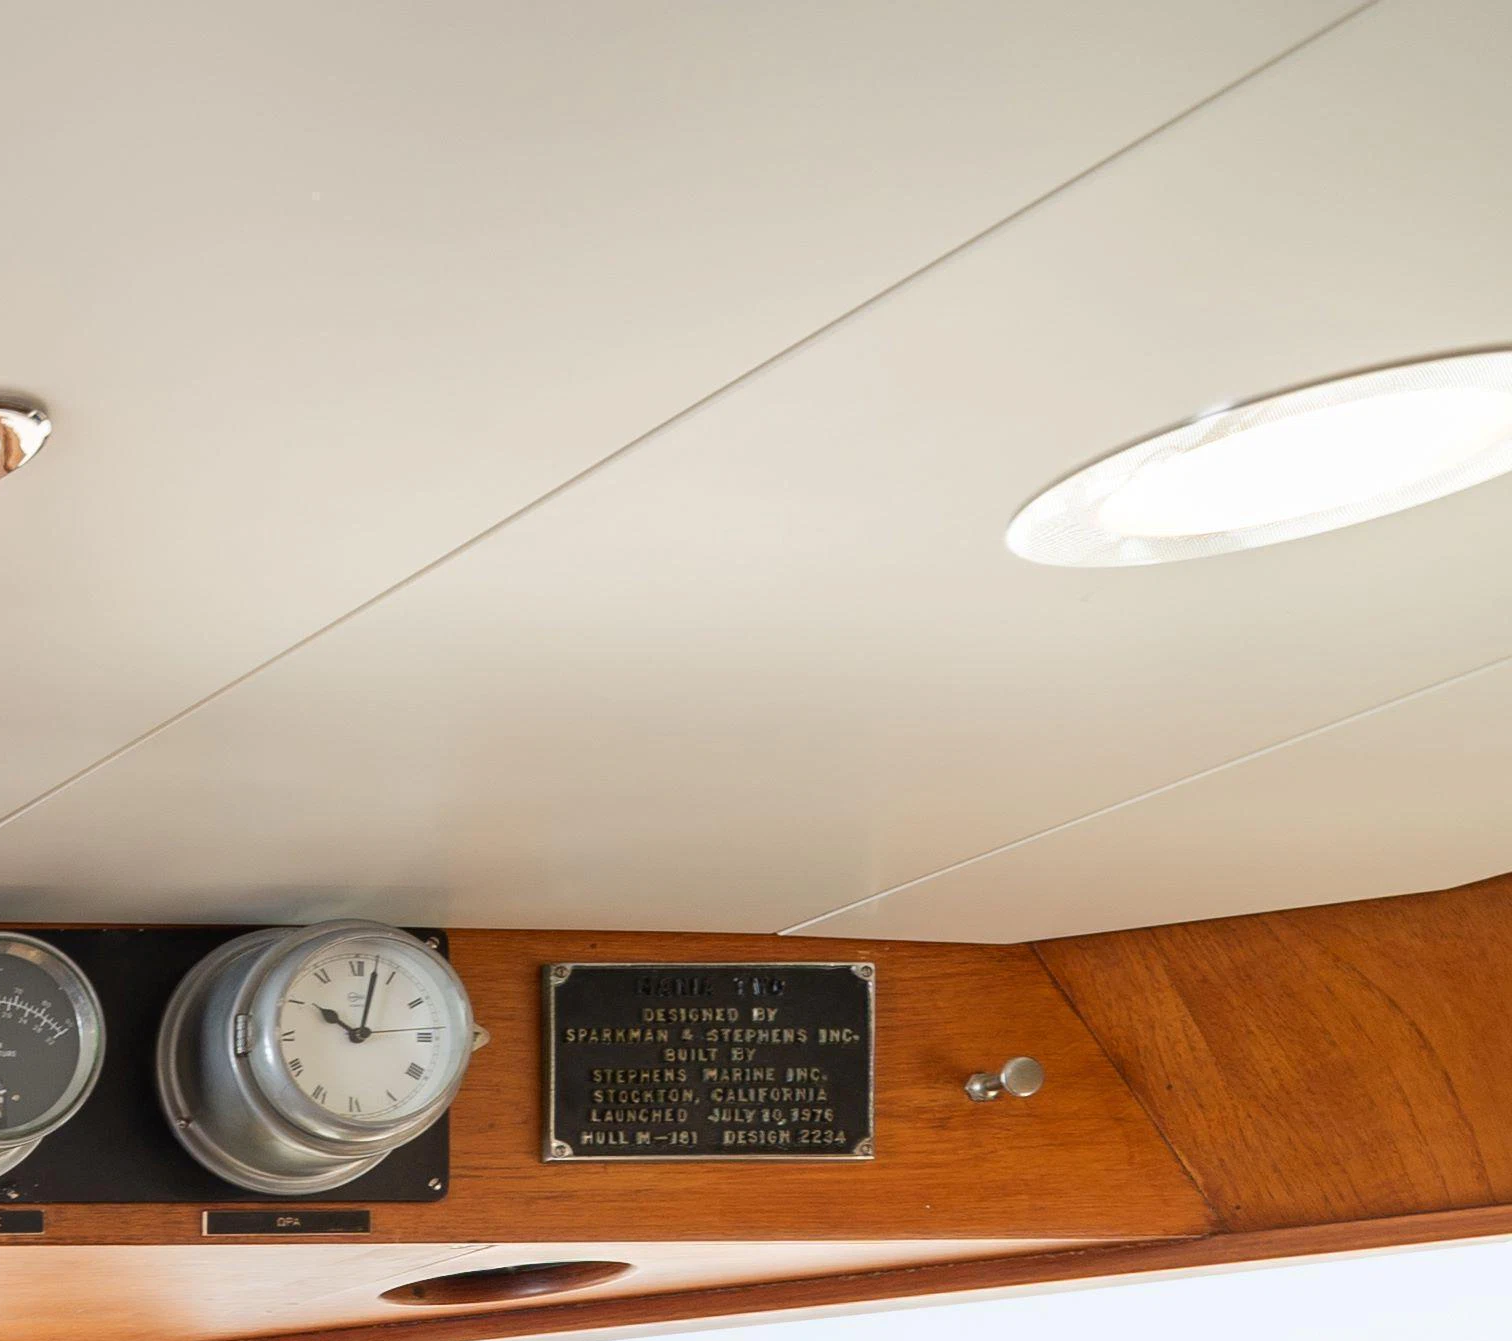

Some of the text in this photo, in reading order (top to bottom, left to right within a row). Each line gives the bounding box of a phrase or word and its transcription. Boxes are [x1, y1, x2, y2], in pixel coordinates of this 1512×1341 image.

[642, 1007, 779, 1022] DESIGNED BY
[565, 1028, 860, 1043] SPARKMAN & STEPHENS INC.
[663, 1048, 756, 1062] BUILT BY
[592, 1067, 828, 1084] STEPHENS MARINE INC.
[592, 1088, 828, 1105] STOCKTON, CALIFORNIA
[591, 1108, 688, 1123] LAUNCHED
[707, 1108, 756, 1123] JULY
[580, 1130, 629, 1145] HULL
[723, 1130, 791, 1145] DESIGN
[799, 1130, 846, 1144] 2234
[276, 1217, 301, 1227] ΩΡΑ
